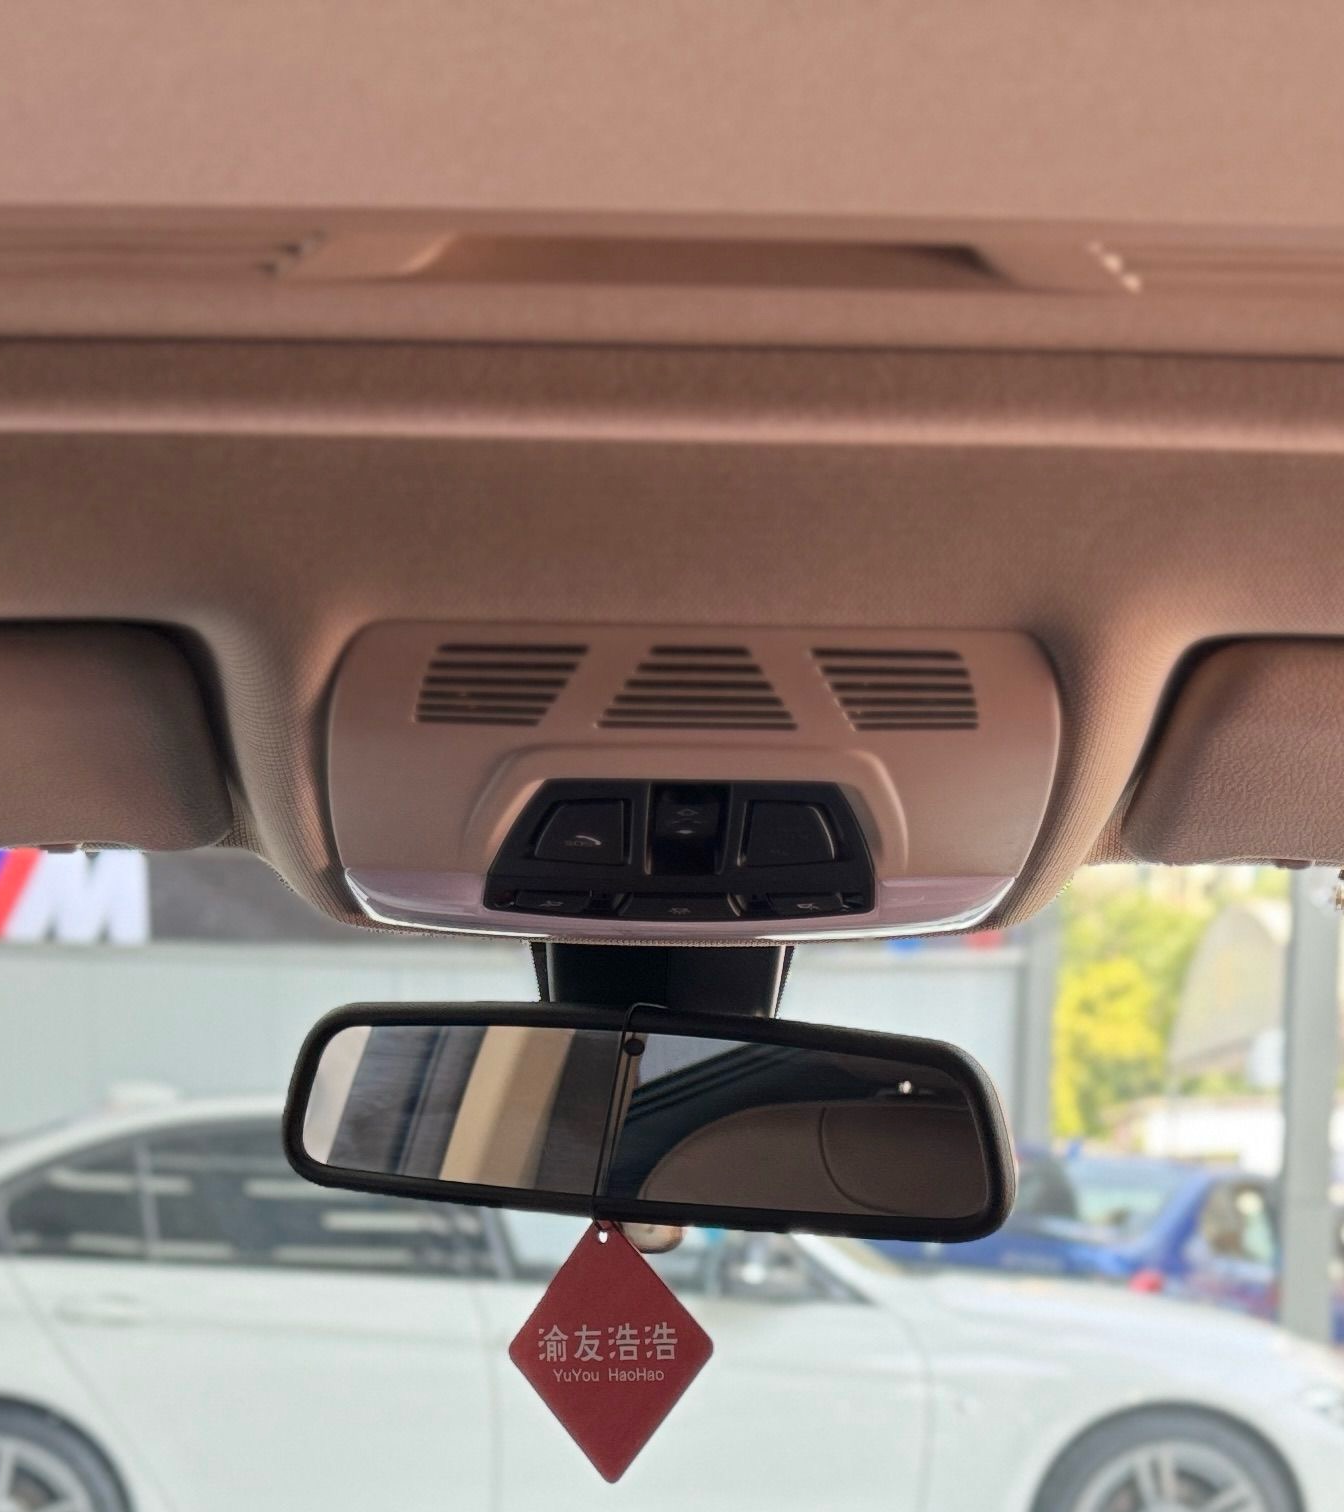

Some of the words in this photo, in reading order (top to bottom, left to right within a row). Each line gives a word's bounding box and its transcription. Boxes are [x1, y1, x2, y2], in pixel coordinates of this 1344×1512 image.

[538, 1322, 678, 1363] 渝友浩浩
[553, 1368, 600, 1383] YuYou
[608, 1368, 665, 1382] HaoHao
